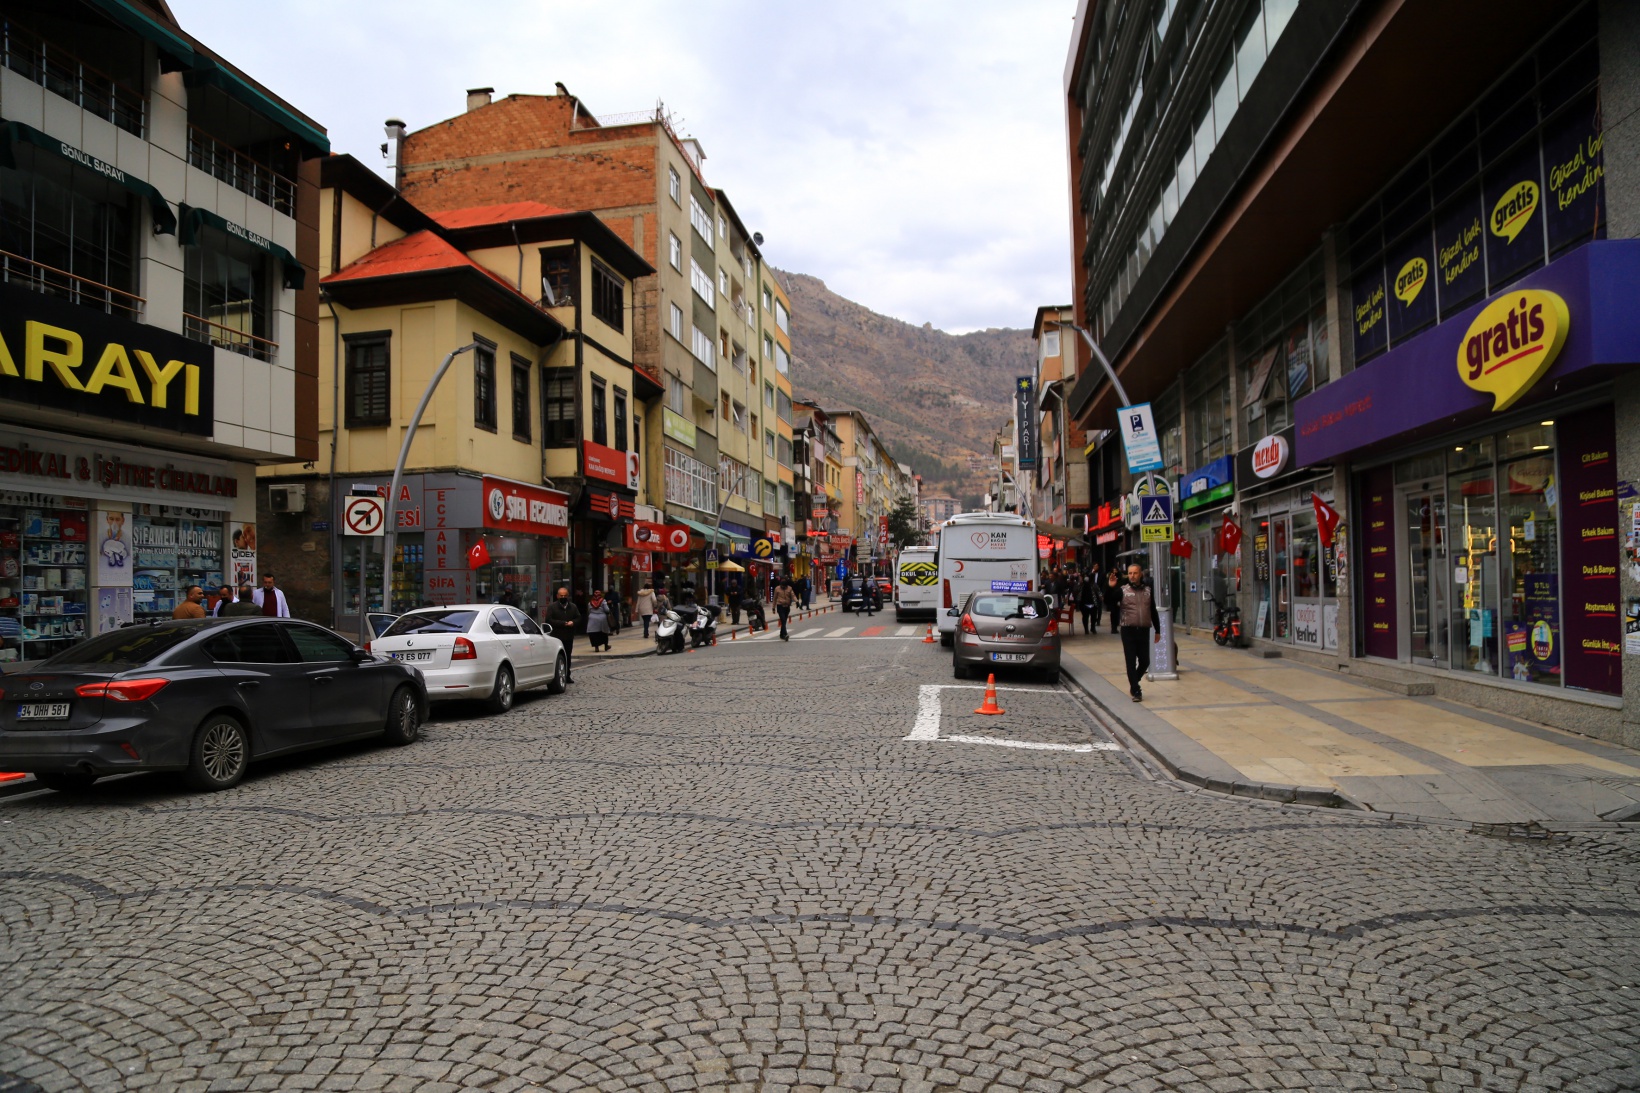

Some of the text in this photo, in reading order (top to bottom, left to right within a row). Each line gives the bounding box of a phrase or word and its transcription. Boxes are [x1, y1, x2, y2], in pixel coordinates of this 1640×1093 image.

[60, 143, 125, 183] GÖNÜL SARAYI
[1549, 132, 1604, 192] Güzel ba
[1558, 164, 1605, 212] kendin
[1494, 184, 1535, 232] gratis
[226, 221, 271, 250] GÖNÜL SARAYI
[1439, 216, 1482, 269] Güzel bak
[1397, 259, 1425, 296] gratis
[1445, 245, 1479, 286] kendine
[1466, 297, 1544, 380] gratis
[1021, 392, 1029, 419] İYİ
[1022, 420, 1030, 458] PARTİ
[1254, 437, 1280, 467] mendy
[1581, 450, 1609, 463] Cilt Bakım
[79, 457, 91, 480] &
[97, 455, 156, 488] İŞİTME
[159, 464, 238, 498] CİHAZLARI
[505, 489, 569, 528] ŞİFA ECZANESİ
[1579, 490, 1597, 502] Kişisel
[1596, 488, 1614, 498] Bakım
[437, 490, 447, 569] ECZANE
[1145, 527, 1162, 535] İLK
[1581, 526, 1614, 538] Erkek Bakım
[231, 548, 255, 559] WIDEX
[429, 575, 455, 591] ŞİFA
[1582, 565, 1616, 575] Duş & Banyo
[1584, 602, 1616, 613] Atıştırmalık
[1295, 626, 1307, 642] Yeni
[1582, 638, 1601, 648] Günlük
[406, 653, 416, 661] ES
[417, 652, 431, 660] 077
[21, 704, 67, 717] 34 DHH 581
